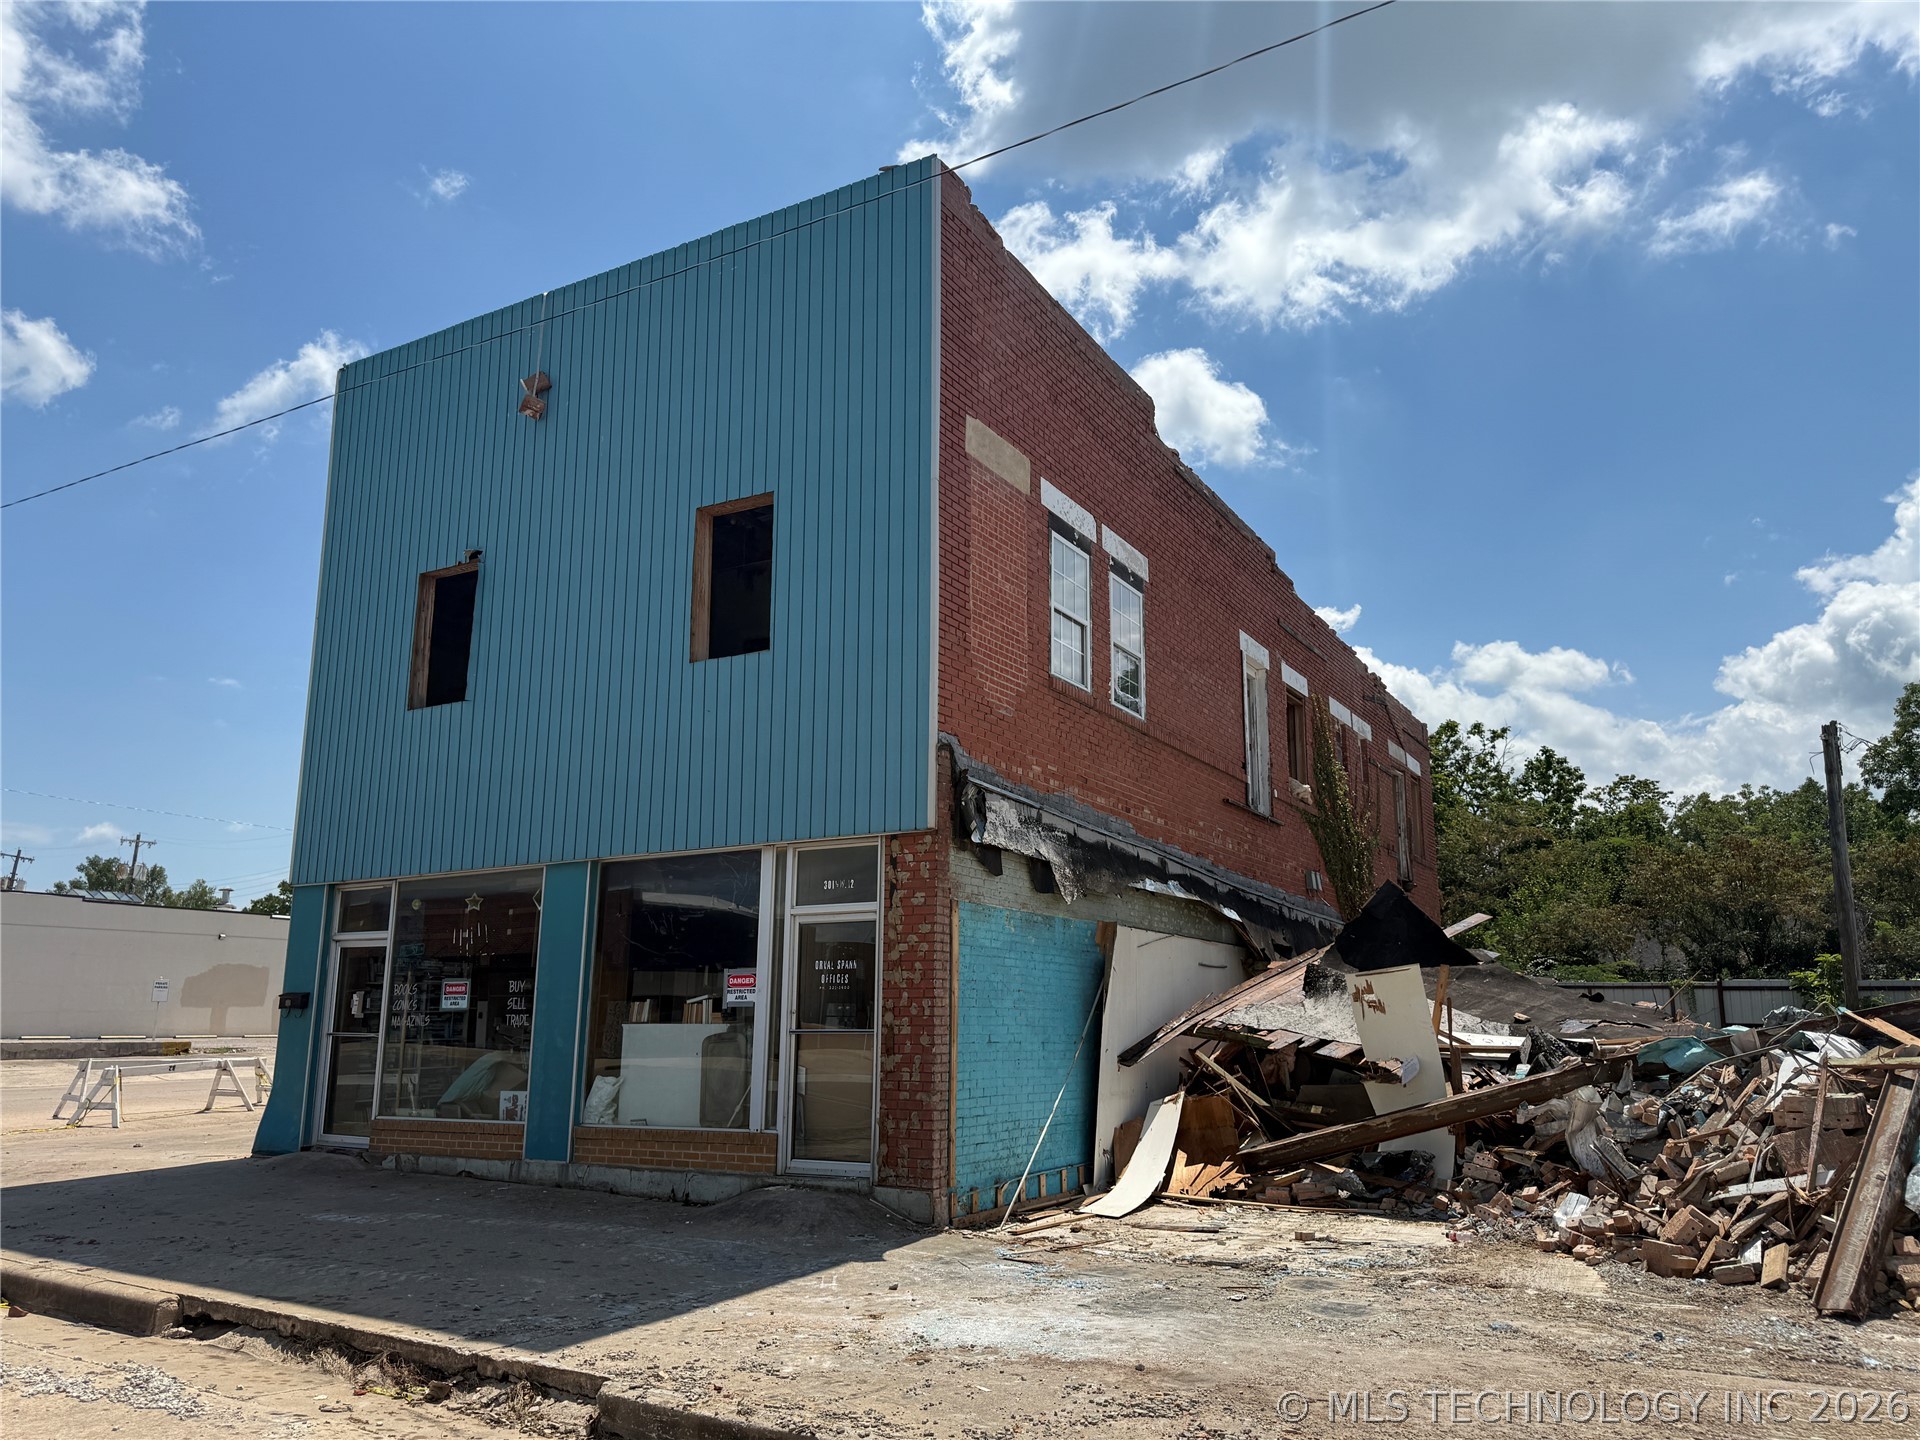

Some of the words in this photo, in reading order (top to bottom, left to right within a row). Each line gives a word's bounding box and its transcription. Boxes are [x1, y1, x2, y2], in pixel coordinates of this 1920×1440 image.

[820, 973, 849, 984] OFFICES
[393, 983, 418, 996] BOOKS
[508, 979, 526, 993] BUY
[506, 996, 527, 1010] SELL
[505, 1013, 530, 1029] TRADE
